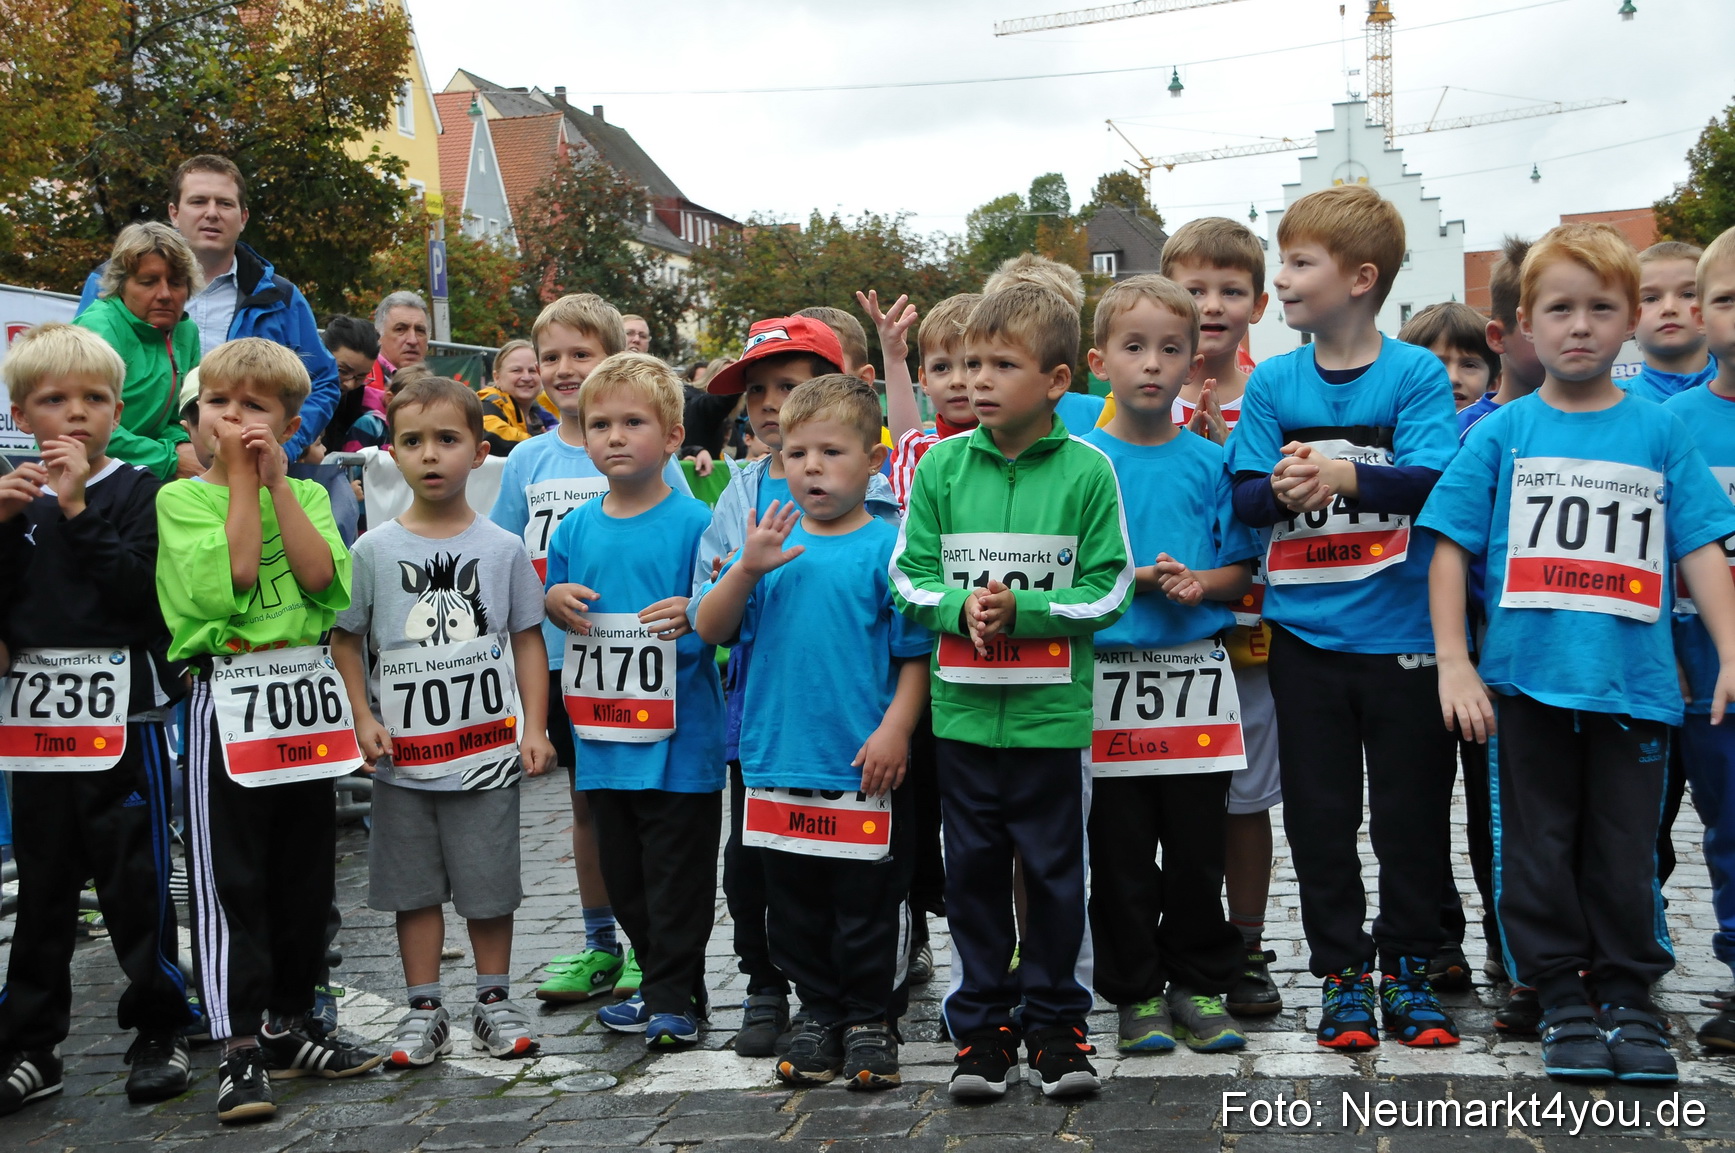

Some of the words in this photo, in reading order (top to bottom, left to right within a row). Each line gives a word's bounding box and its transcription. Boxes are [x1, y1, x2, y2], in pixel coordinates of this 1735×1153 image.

[432, 247, 443, 291] P
[1516, 473, 1566, 487] PARTL
[1571, 475, 1650, 498] Neumarkt
[530, 491, 561, 506] PARTL
[1396, 518, 1403, 527] K
[1526, 496, 1652, 561] 7011
[943, 548, 976, 562] PARTL
[979, 548, 1052, 564] Neumarkt
[1306, 544, 1362, 563] Lukas
[1513, 547, 1519, 556] 2
[1652, 560, 1658, 569] K
[1543, 564, 1626, 593] Vincent
[594, 627, 653, 638] Neumarkt
[37, 654, 103, 666] Neumarkt
[383, 661, 423, 676] PARTL
[426, 650, 489, 672] Neumarkt
[1094, 651, 1139, 664] PARTL
[1143, 651, 1206, 665] Neumarkt
[214, 666, 266, 682] PARTL
[269, 660, 325, 676] Neumarkt
[572, 643, 664, 693] 7170
[11, 671, 115, 719] 7236
[393, 667, 504, 729] 7070
[664, 689, 669, 697] K
[1103, 667, 1222, 721] 7577
[231, 675, 343, 733] 7006
[593, 703, 631, 723] Kilian
[115, 715, 121, 723] K
[344, 718, 350, 727] K
[1229, 712, 1235, 721] K
[228, 732, 234, 741] 2
[390, 728, 396, 736] 2
[34, 733, 77, 752] Timo
[277, 741, 312, 763] Toni
[394, 741, 454, 762] Johann
[459, 727, 513, 753] Maxim
[1107, 732, 1169, 756] Elias
[751, 788, 756, 796] 2
[879, 799, 886, 809] K
[789, 811, 837, 835] Matti
